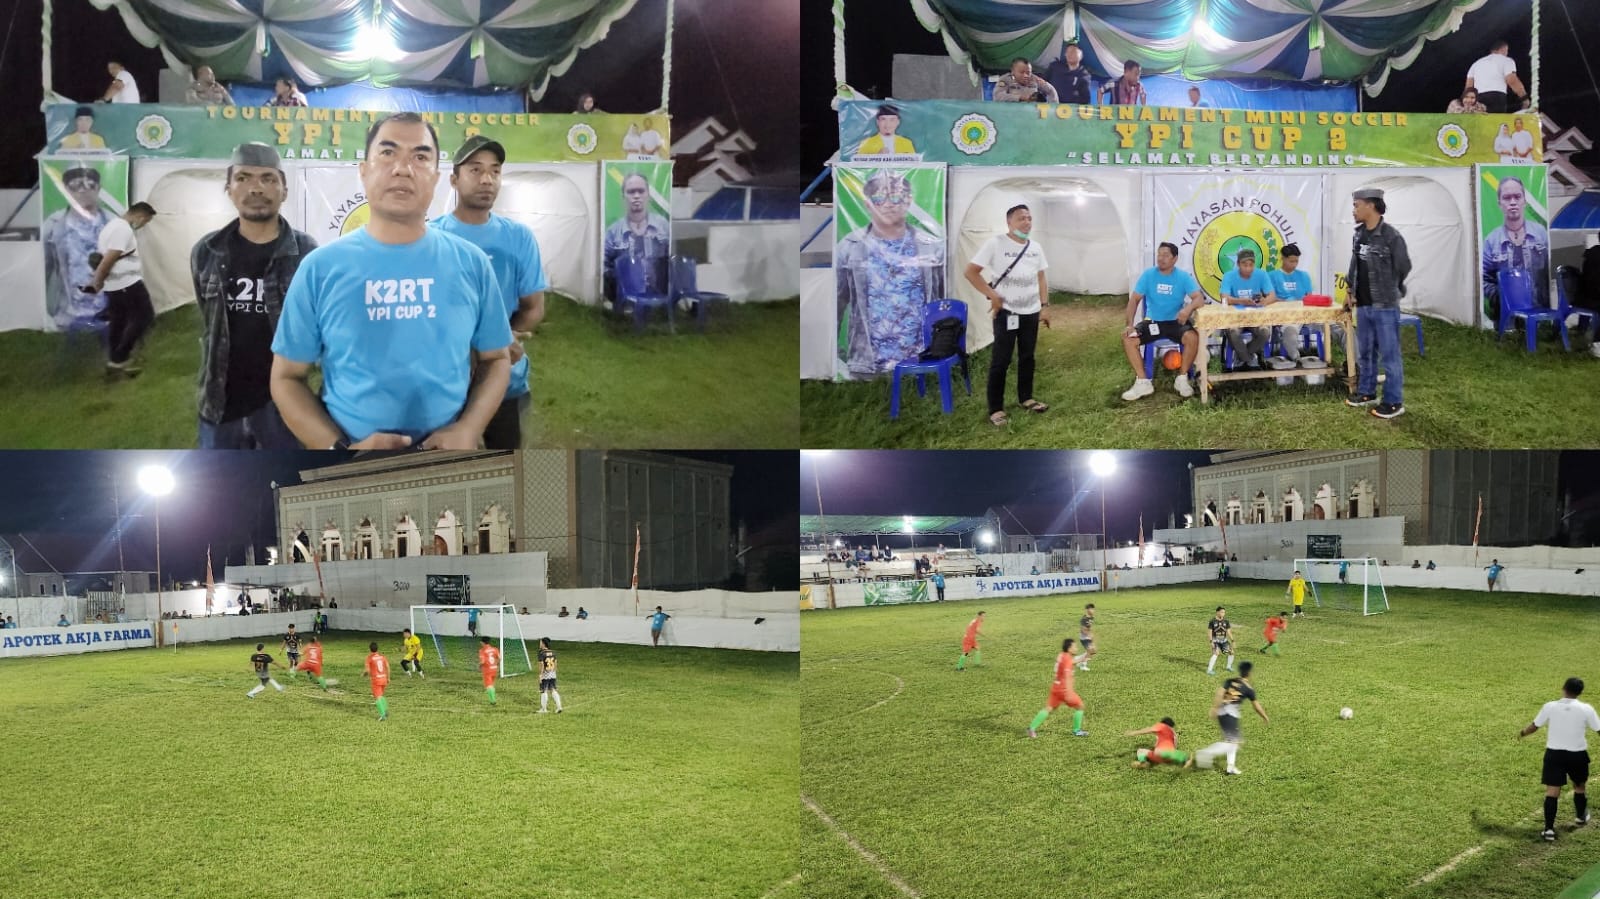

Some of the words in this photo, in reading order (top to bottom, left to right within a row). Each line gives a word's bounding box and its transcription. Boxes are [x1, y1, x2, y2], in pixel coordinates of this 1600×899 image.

[207, 106, 377, 123] TOURNAMENT
[421, 112, 444, 124] NI
[456, 113, 540, 126] SOCCER
[1036, 103, 1232, 123] TOURNAMENT
[1245, 111, 1306, 125] MINI
[1317, 112, 1408, 126] SOCCER
[273, 122, 342, 146] YPI
[1115, 123, 1194, 149] YPI
[1223, 125, 1302, 150] CUP
[1329, 127, 1347, 150] 2
[1181, 197, 1244, 248] YAYASAN
[365, 278, 435, 305] K2RT
[256, 303, 270, 314] CU
[367, 306, 390, 321] YPI
[395, 305, 423, 319] CUP
[427, 305, 437, 318] 2
[992, 581, 1034, 591] APOTEK
[1037, 579, 1063, 589] AKJA
[1064, 576, 1099, 587] FARMA
[3, 634, 62, 648] APOTEK
[65, 631, 102, 645] AKJA
[104, 628, 152, 641] FARMA
